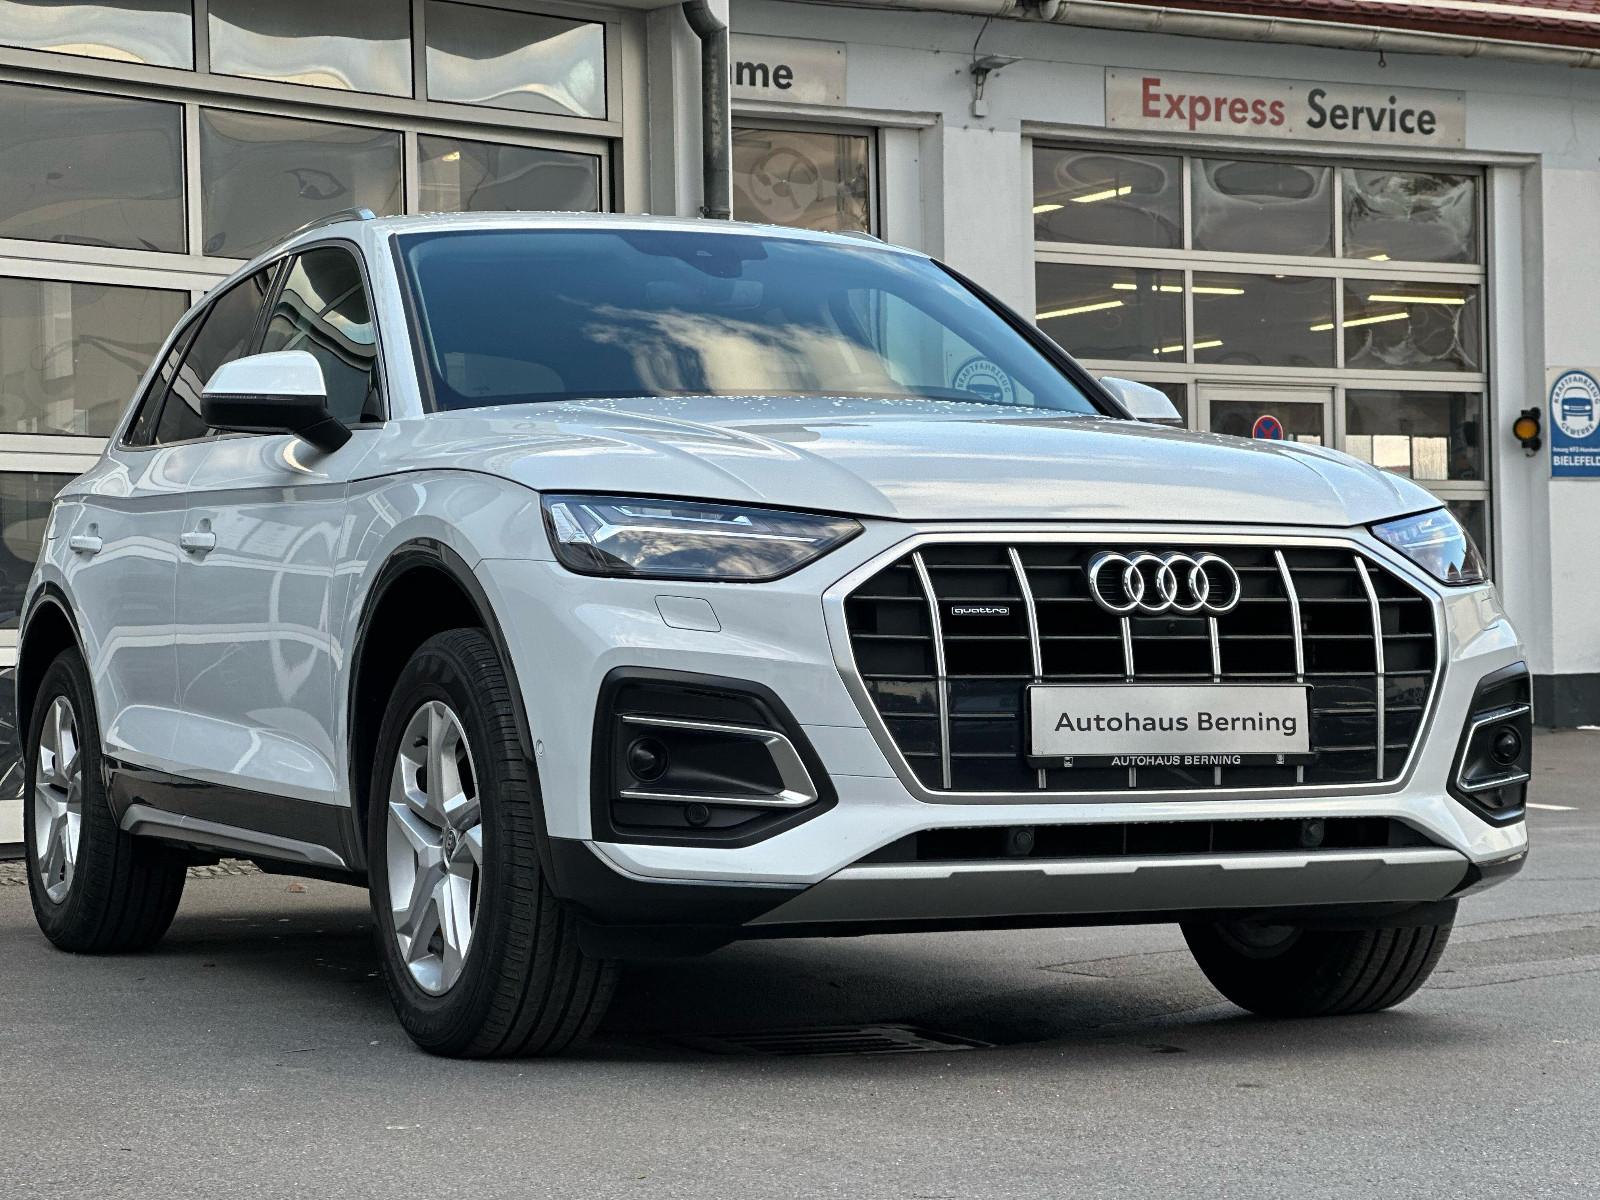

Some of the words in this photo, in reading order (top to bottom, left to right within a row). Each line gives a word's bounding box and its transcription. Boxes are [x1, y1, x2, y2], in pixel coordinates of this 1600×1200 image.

[730, 61, 794, 90] me
[1141, 77, 1286, 131] Express
[1305, 88, 1437, 135] Service
[954, 607, 1008, 615] quattro
[1054, 712, 1189, 732] Autohaus
[1197, 712, 1297, 736] Berning
[1111, 755, 1181, 766] AUTOHAUS
[1184, 754, 1242, 765] BERNING
